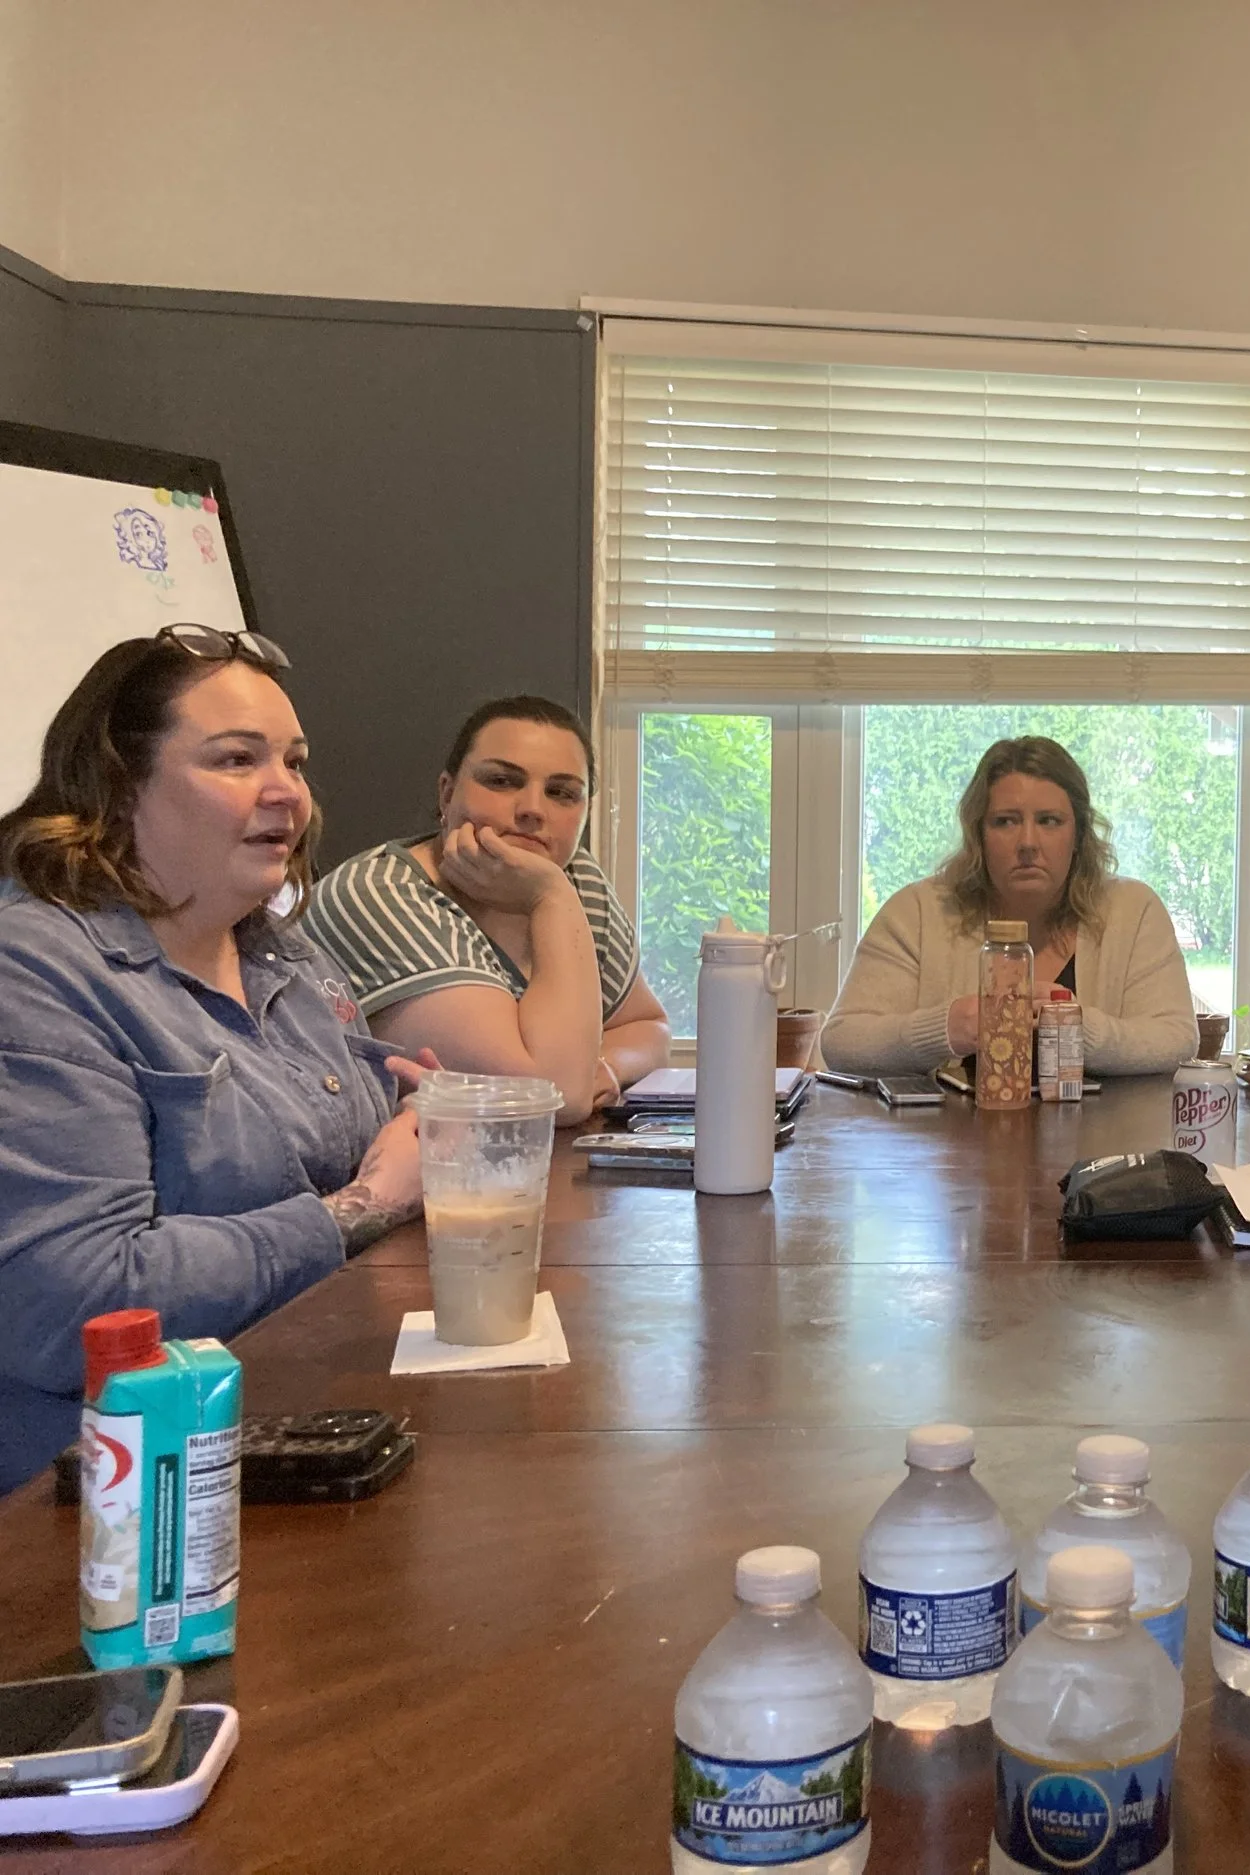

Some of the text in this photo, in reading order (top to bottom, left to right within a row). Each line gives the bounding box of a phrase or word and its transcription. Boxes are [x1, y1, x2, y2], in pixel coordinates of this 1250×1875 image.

[1172, 1090, 1227, 1127] Pepper
[1187, 1087, 1213, 1108] Dr
[1178, 1135, 1198, 1149] Diet
[695, 1796, 838, 1829] ICE MOUNTAIN
[1031, 1805, 1105, 1827] NICOLET
